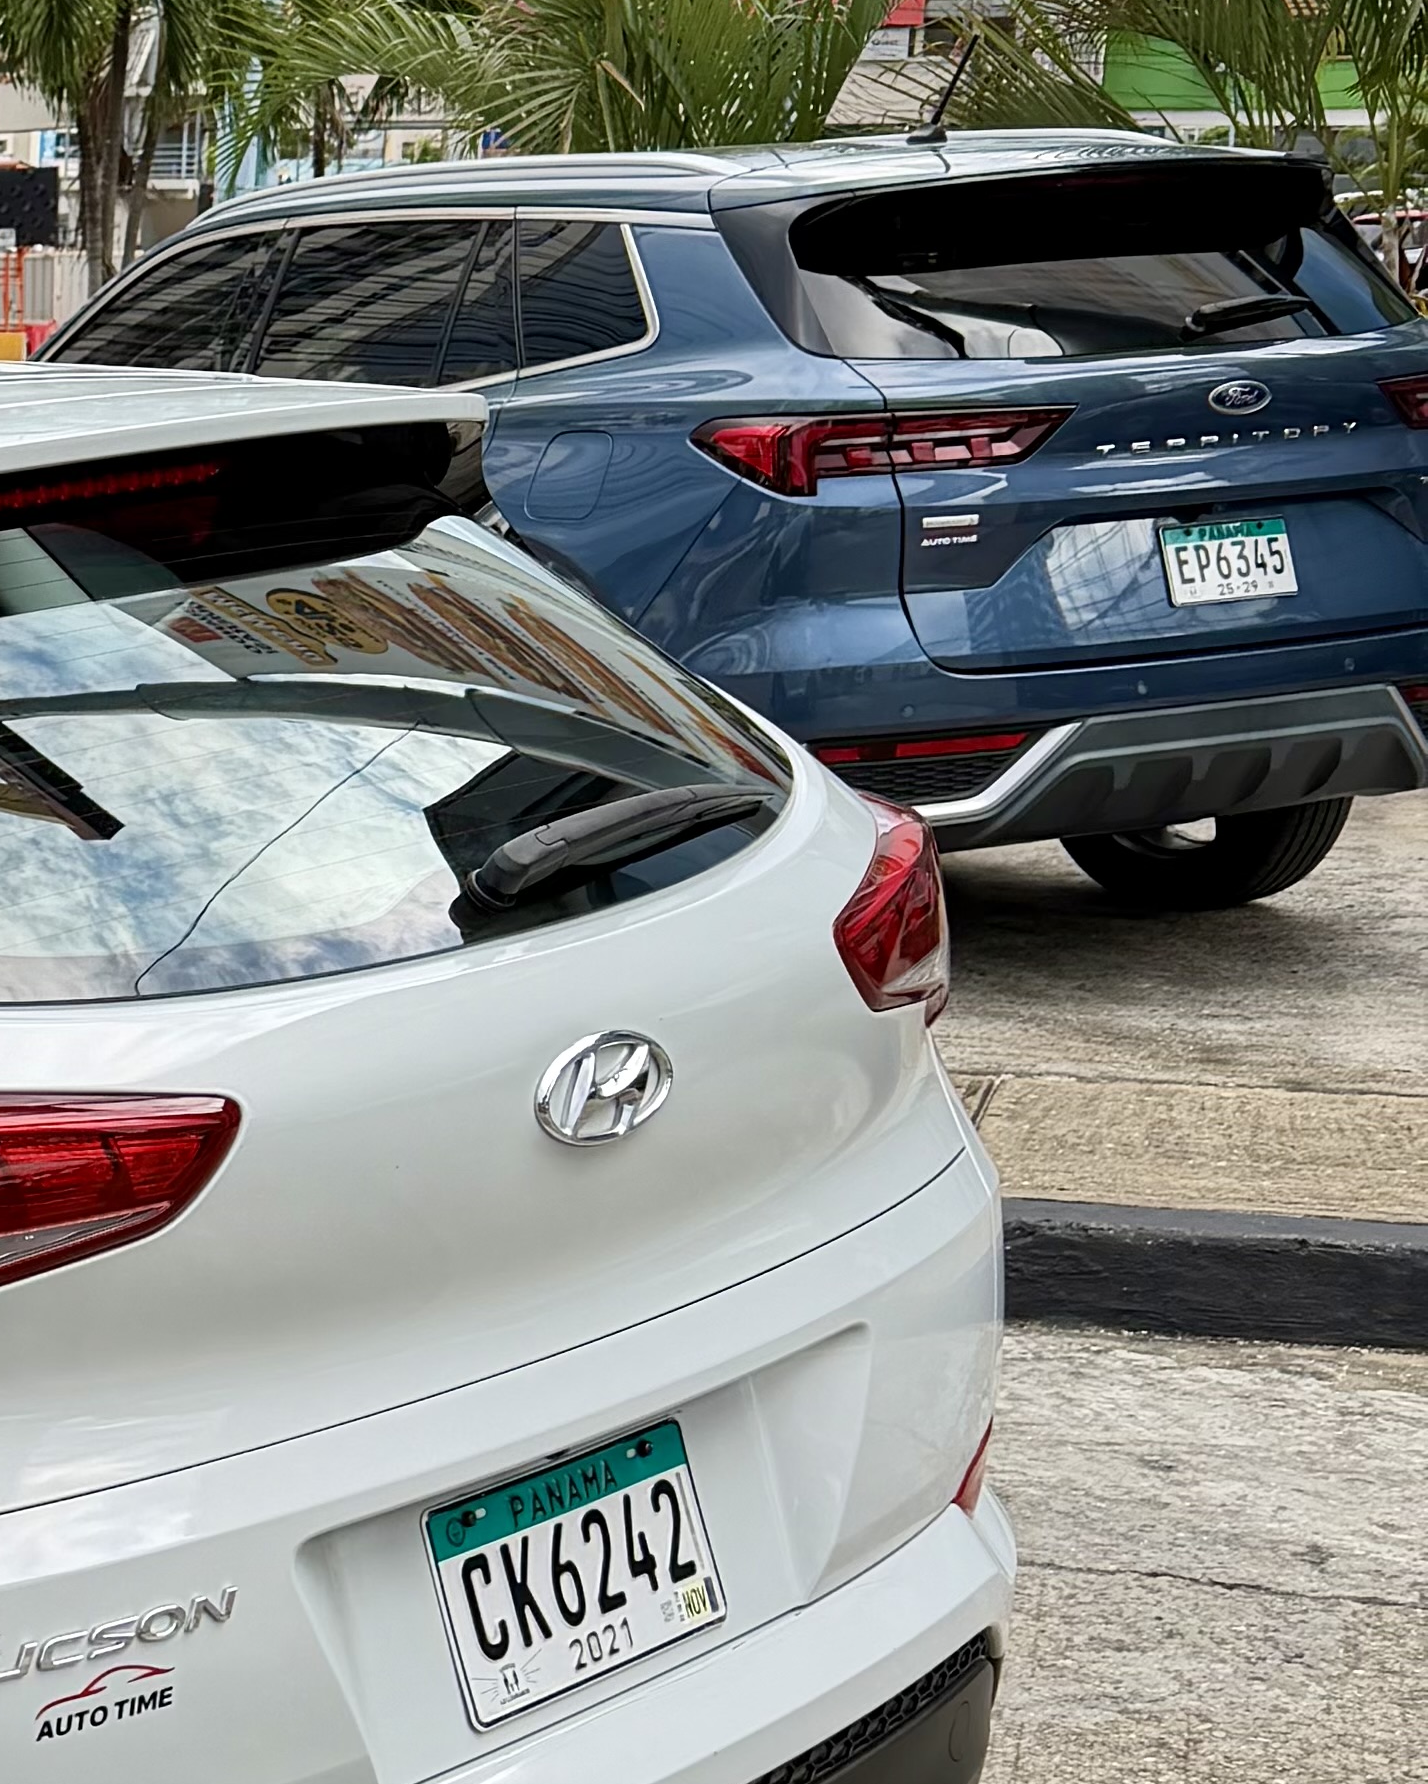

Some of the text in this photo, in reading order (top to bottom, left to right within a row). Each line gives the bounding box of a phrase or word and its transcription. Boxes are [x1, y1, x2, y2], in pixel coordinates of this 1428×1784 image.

[1096, 421, 1357, 456] TERRITORY
[1198, 522, 1254, 541] PANAMA
[1175, 537, 1285, 585] EP6345
[507, 1460, 618, 1528] PANAMA
[461, 1478, 697, 1662] CK6242
[683, 1585, 708, 1618] NOV
[568, 1617, 634, 1672] 2021
[36, 1686, 174, 1742] AUTO TIME
